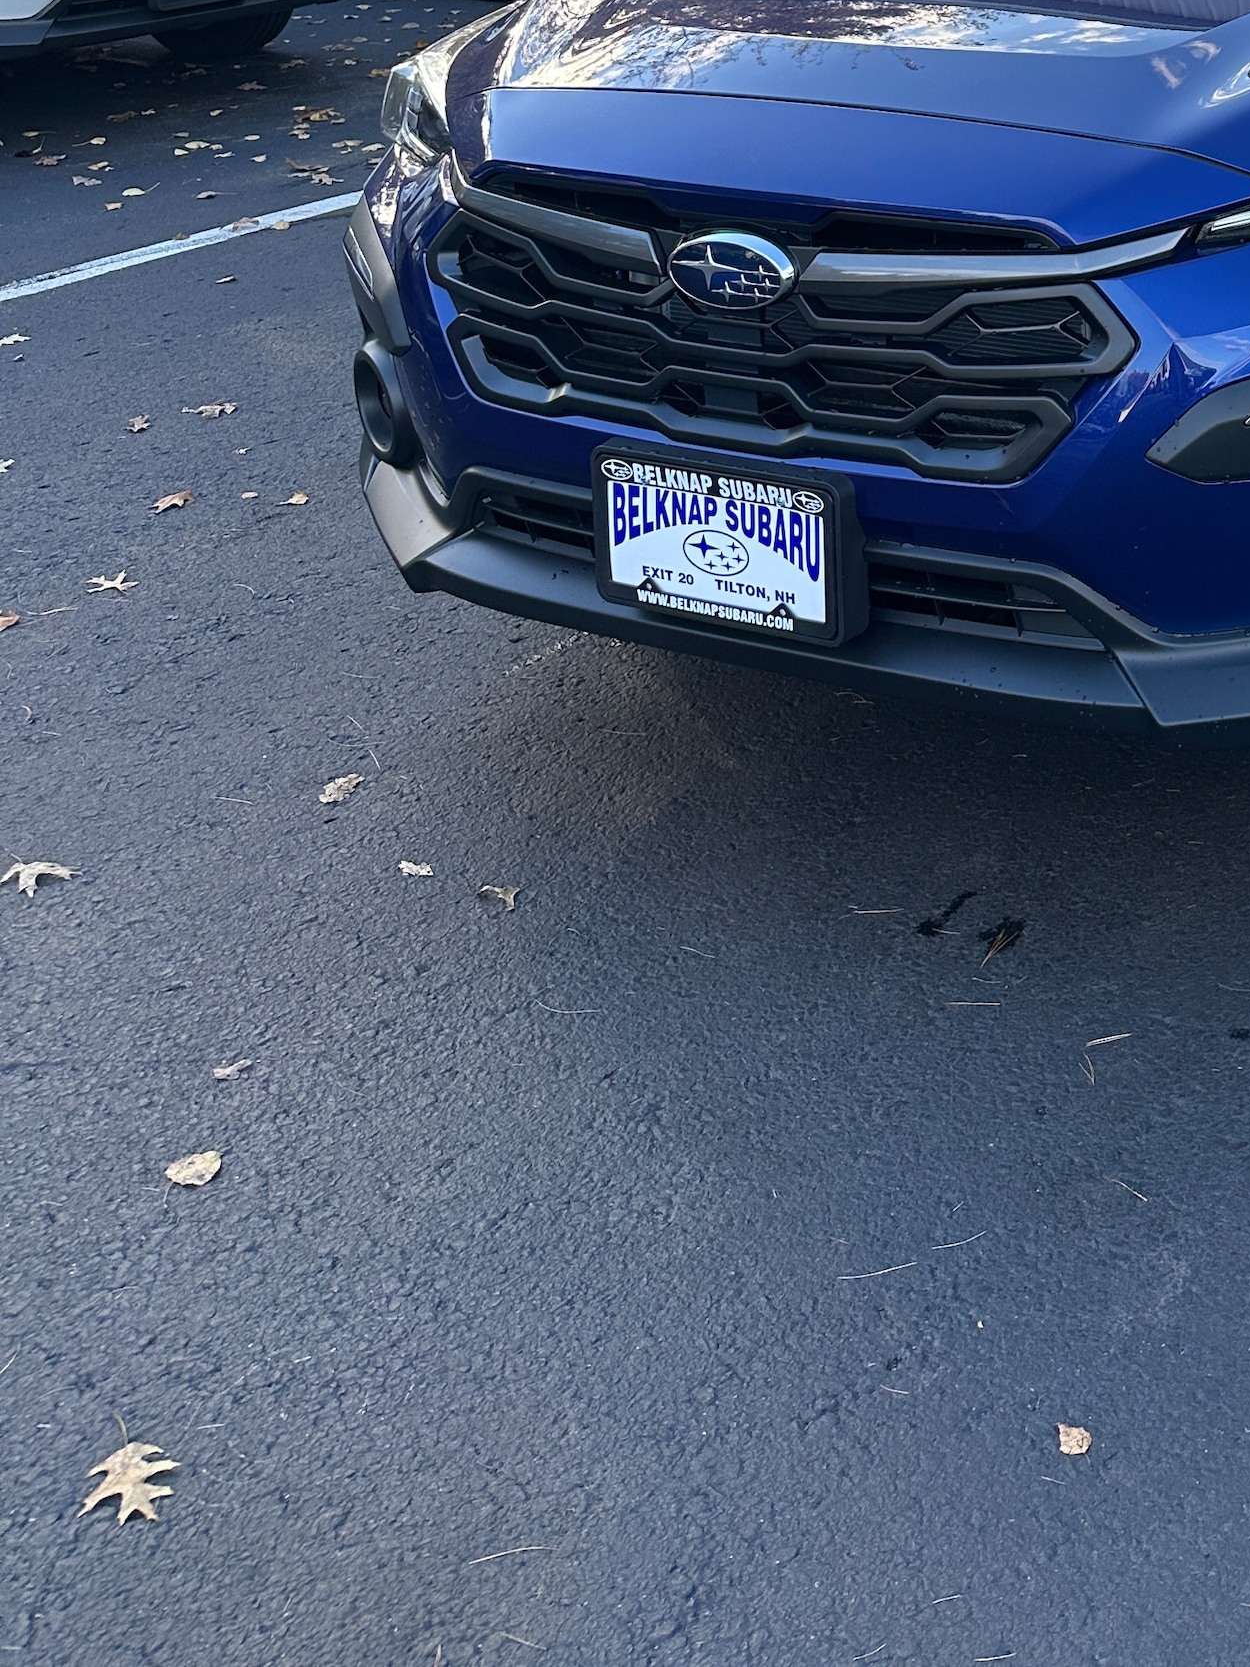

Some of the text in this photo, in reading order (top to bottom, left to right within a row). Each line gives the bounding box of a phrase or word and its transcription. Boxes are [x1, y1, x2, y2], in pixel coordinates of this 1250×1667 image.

[632, 462, 793, 508] BELKNAP SUBARU
[613, 482, 820, 582] BELKNAP SUBARU
[642, 565, 796, 604] EXIT 20 TILTON, NH
[636, 588, 794, 632] WWW.BELKNAPSUBARU.COM
